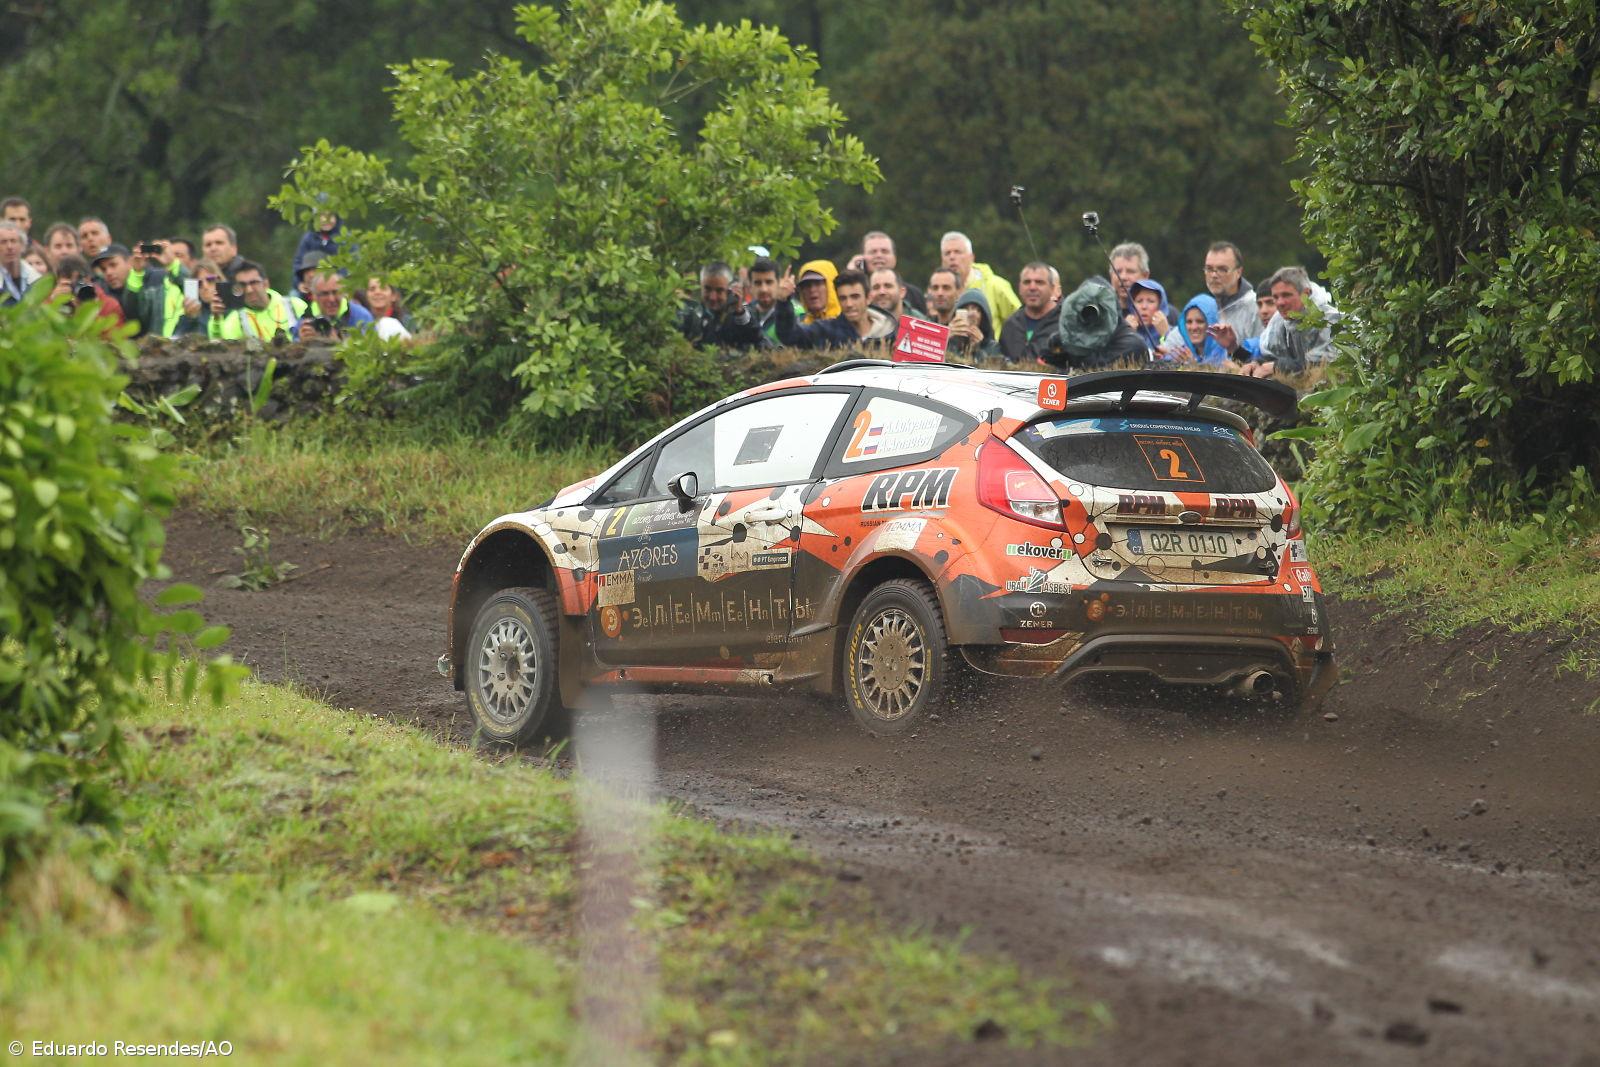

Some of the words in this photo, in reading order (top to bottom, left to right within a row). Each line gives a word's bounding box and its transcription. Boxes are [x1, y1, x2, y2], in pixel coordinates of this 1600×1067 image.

[1042, 397, 1060, 406] ZENER
[846, 410, 872, 458] 2
[1159, 448, 1188, 478] 2
[861, 467, 959, 512] RPM
[605, 506, 627, 536] 2
[1017, 542, 1063, 559] ekover
[1132, 545, 1142, 553] CZ
[1188, 535, 1227, 555] 0110
[617, 543, 678, 572] AZORES
[1006, 580, 1027, 592] URAL
[1042, 582, 1072, 595] ASBEST
[1020, 620, 1053, 628] ZENER
